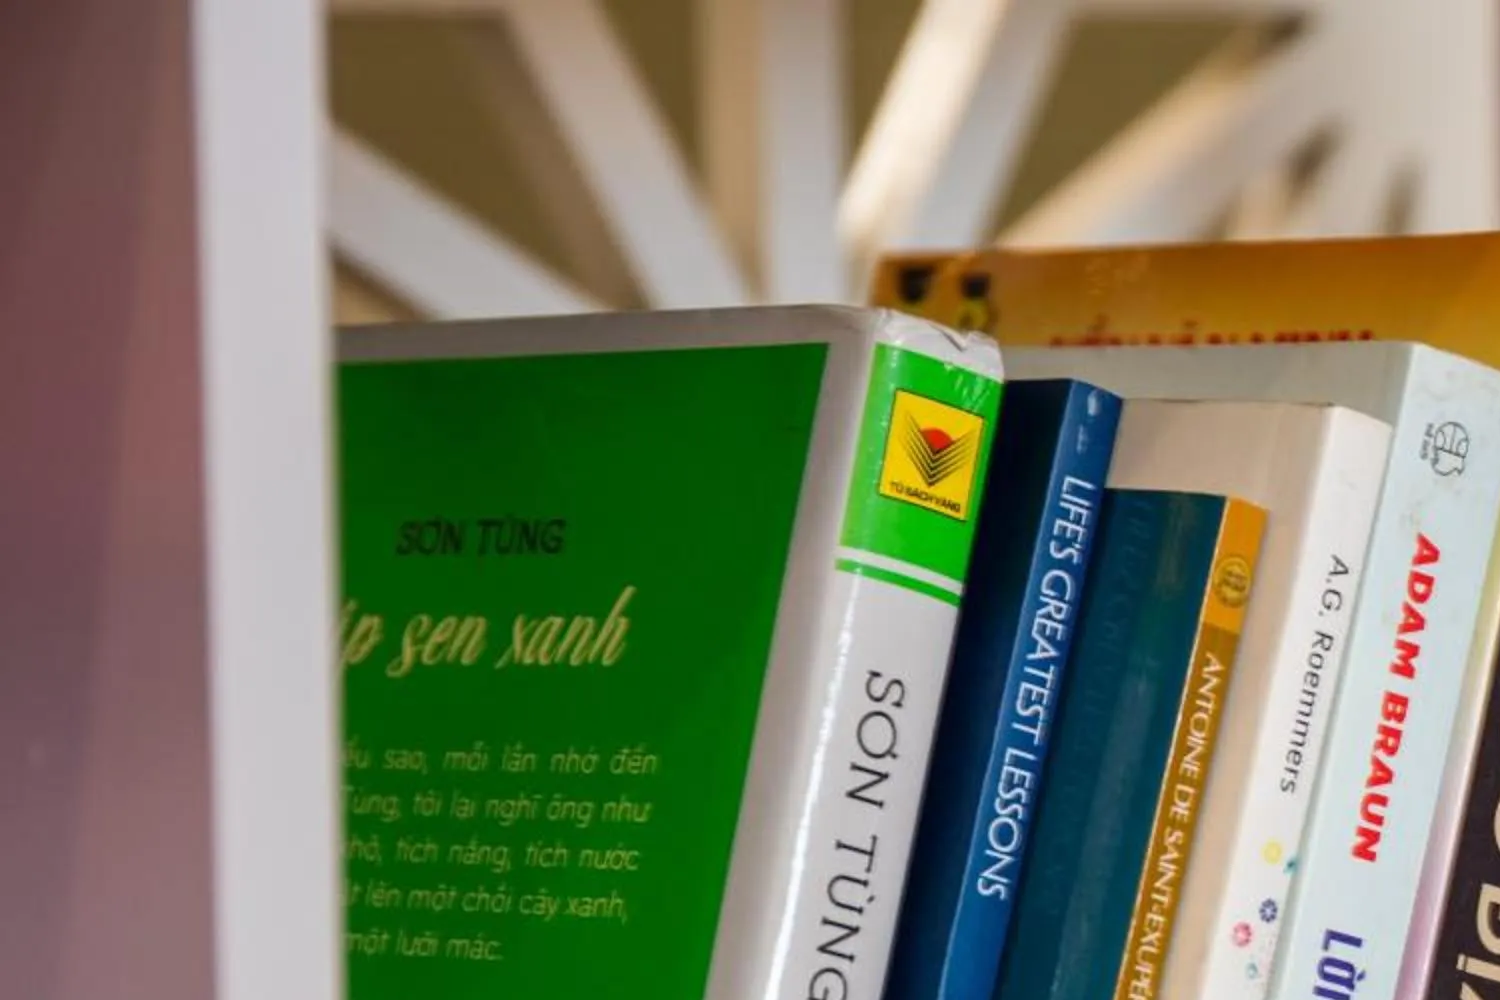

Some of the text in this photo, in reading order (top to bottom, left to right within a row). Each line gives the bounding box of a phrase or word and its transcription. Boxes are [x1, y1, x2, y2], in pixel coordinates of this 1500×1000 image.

[385, 613, 487, 678] sen
[494, 584, 637, 666] xanh
[977, 476, 1097, 901] LIFE'S GREATEST LESSONS
[1279, 554, 1349, 794] A.G. Roemmers
[1351, 532, 1441, 863] ADAM BRAUN
[845, 670, 905, 809] SƠN
[1180, 652, 1226, 775] ANTOINE
[1175, 781, 1198, 826] DE
